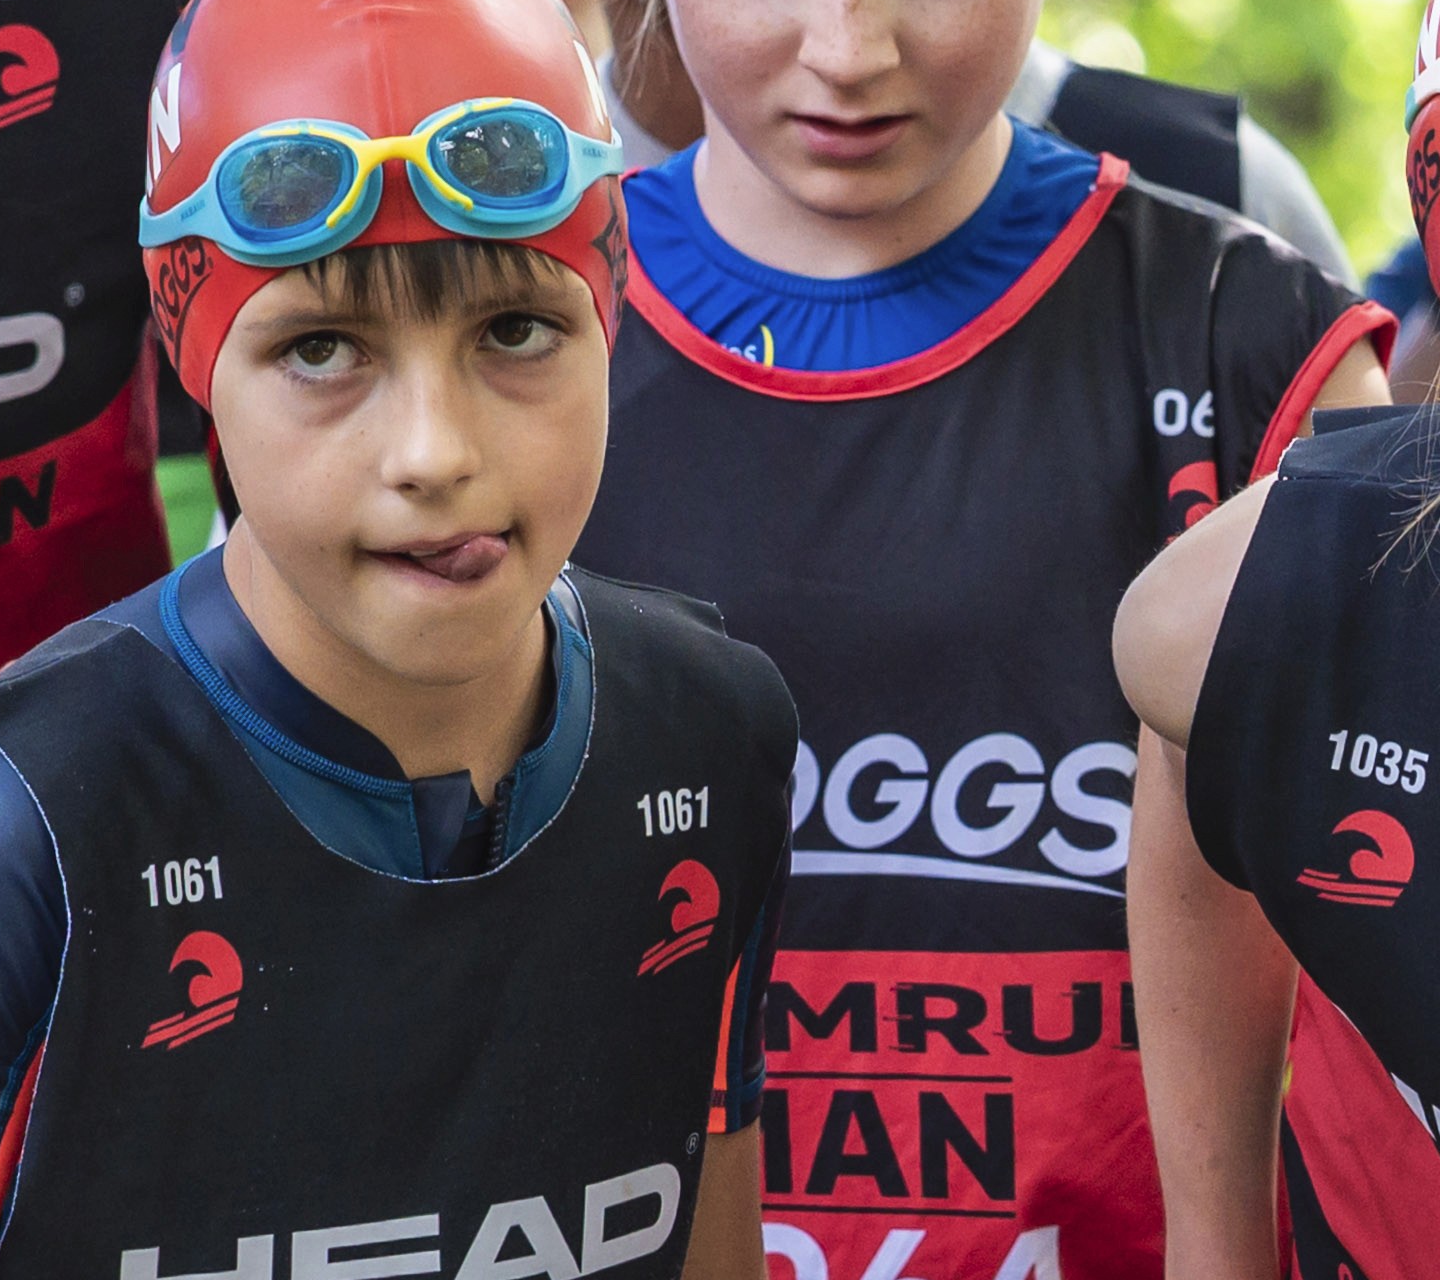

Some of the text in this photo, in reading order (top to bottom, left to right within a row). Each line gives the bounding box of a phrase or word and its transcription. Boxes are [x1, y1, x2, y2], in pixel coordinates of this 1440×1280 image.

[1326, 729, 1430, 795] 1035
[637, 786, 711, 838] 1061
[141, 855, 224, 907] 1061
[762, 1089, 1017, 1202] AN
